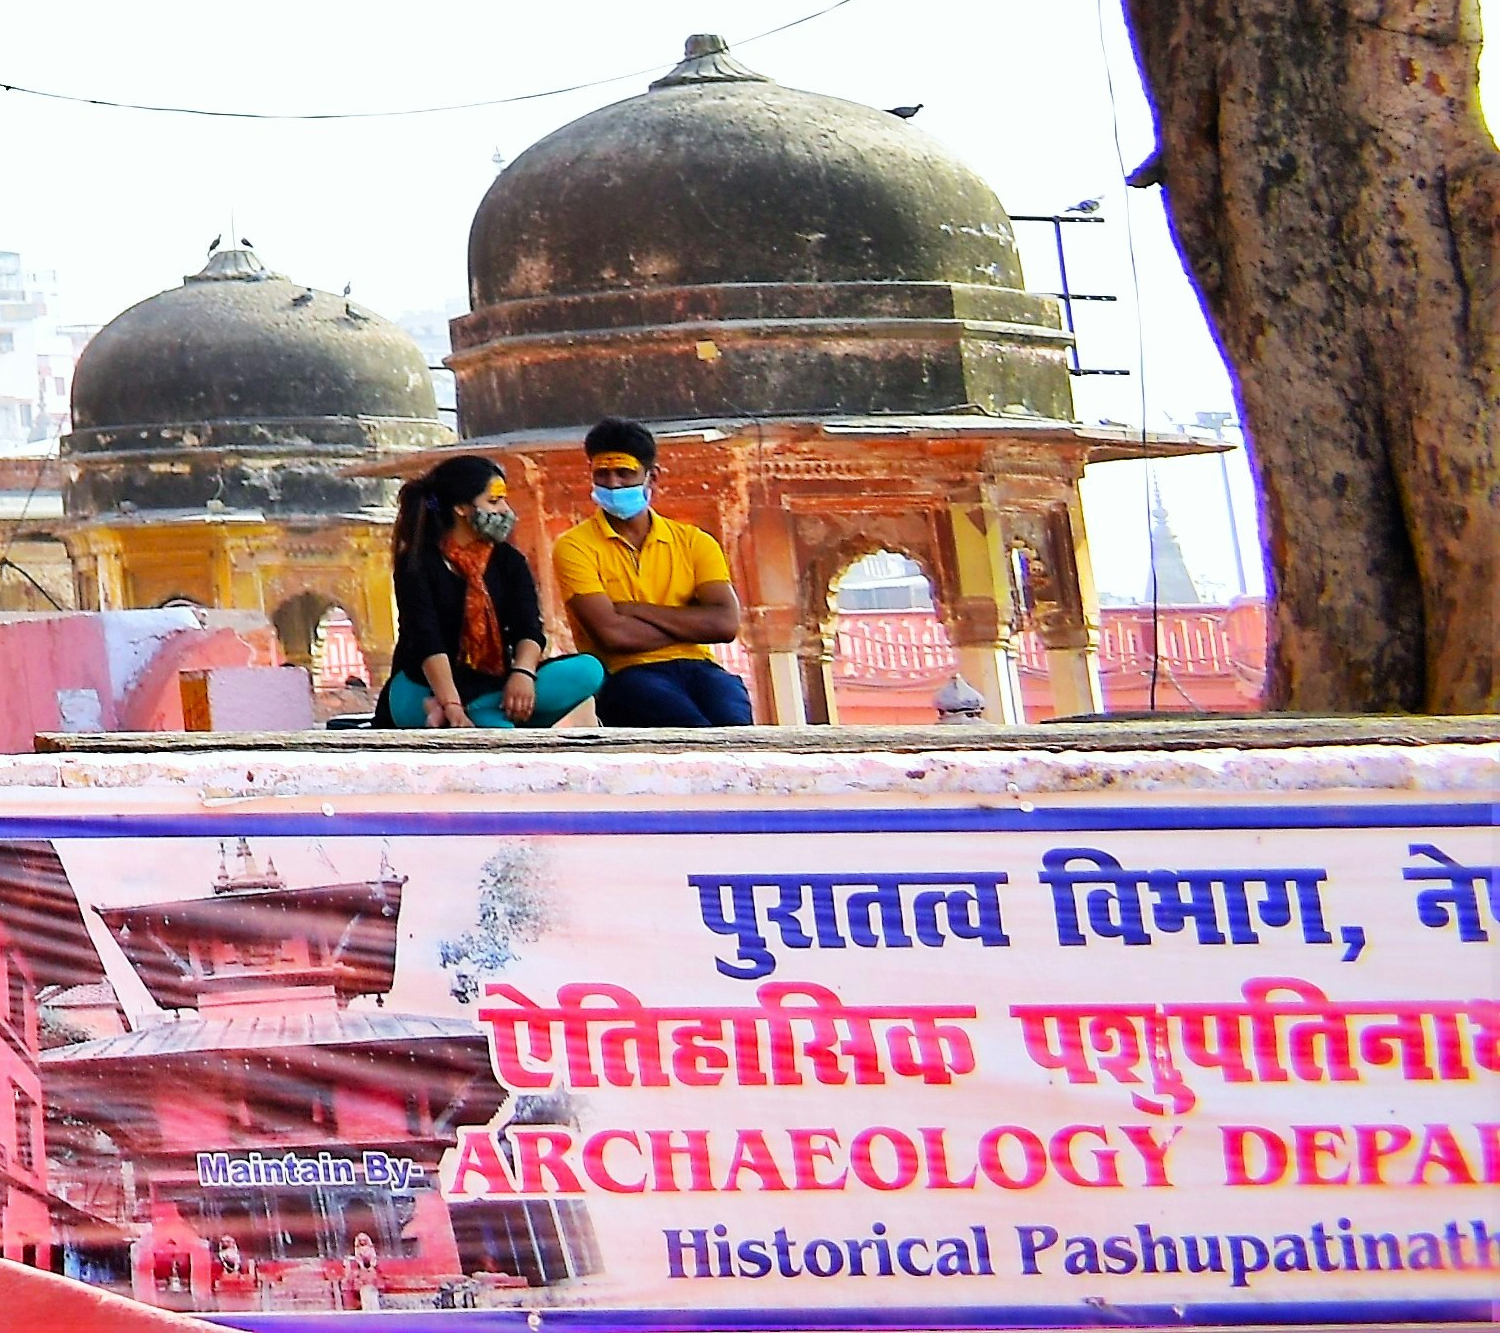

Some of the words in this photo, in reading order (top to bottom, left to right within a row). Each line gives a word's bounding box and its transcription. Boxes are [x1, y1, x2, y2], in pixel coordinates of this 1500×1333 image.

[687, 871, 1011, 980] पुरातत्व
[1038, 846, 1366, 963] विभाग,
[1403, 843, 1500, 944] ने
[479, 980, 977, 1089] ऐतिहासिक
[198, 1153, 354, 1185] Maintain
[363, 1151, 424, 1191] By-
[448, 1123, 1183, 1194] ARCHAEOLOGY
[662, 1222, 996, 1278] Historical
